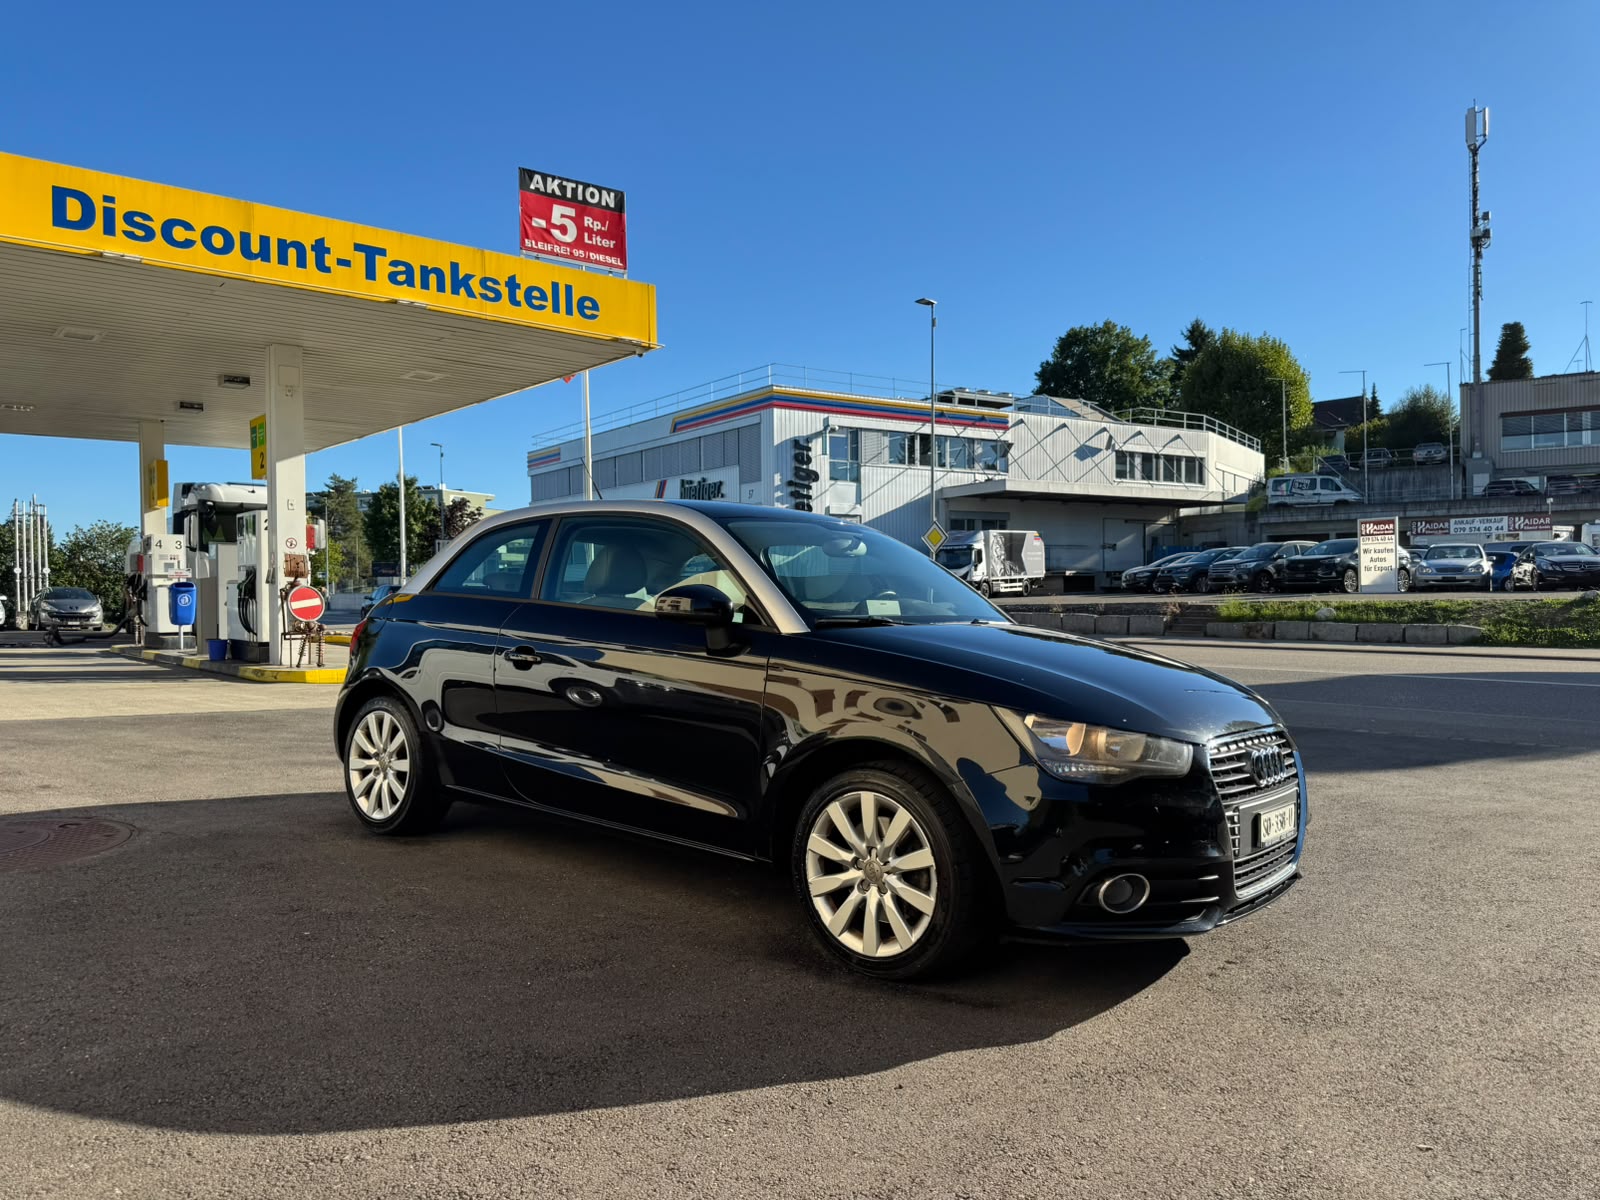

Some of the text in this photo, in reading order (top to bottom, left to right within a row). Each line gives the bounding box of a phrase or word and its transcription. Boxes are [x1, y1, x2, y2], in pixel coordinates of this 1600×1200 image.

[529, 173, 615, 208] AKTION
[531, 203, 578, 243] -5
[525, 239, 570, 255] BLEIFREI
[584, 232, 616, 248] Liter
[51, 184, 601, 321] Discount-Tankstelle
[259, 451, 265, 469] 2
[1366, 523, 1393, 534] HAIDAR
[1417, 521, 1449, 533] HAIDAR
[1515, 516, 1550, 529] HAIDAR
[155, 539, 182, 550] 4 3
[1373, 564, 1393, 572] Export
